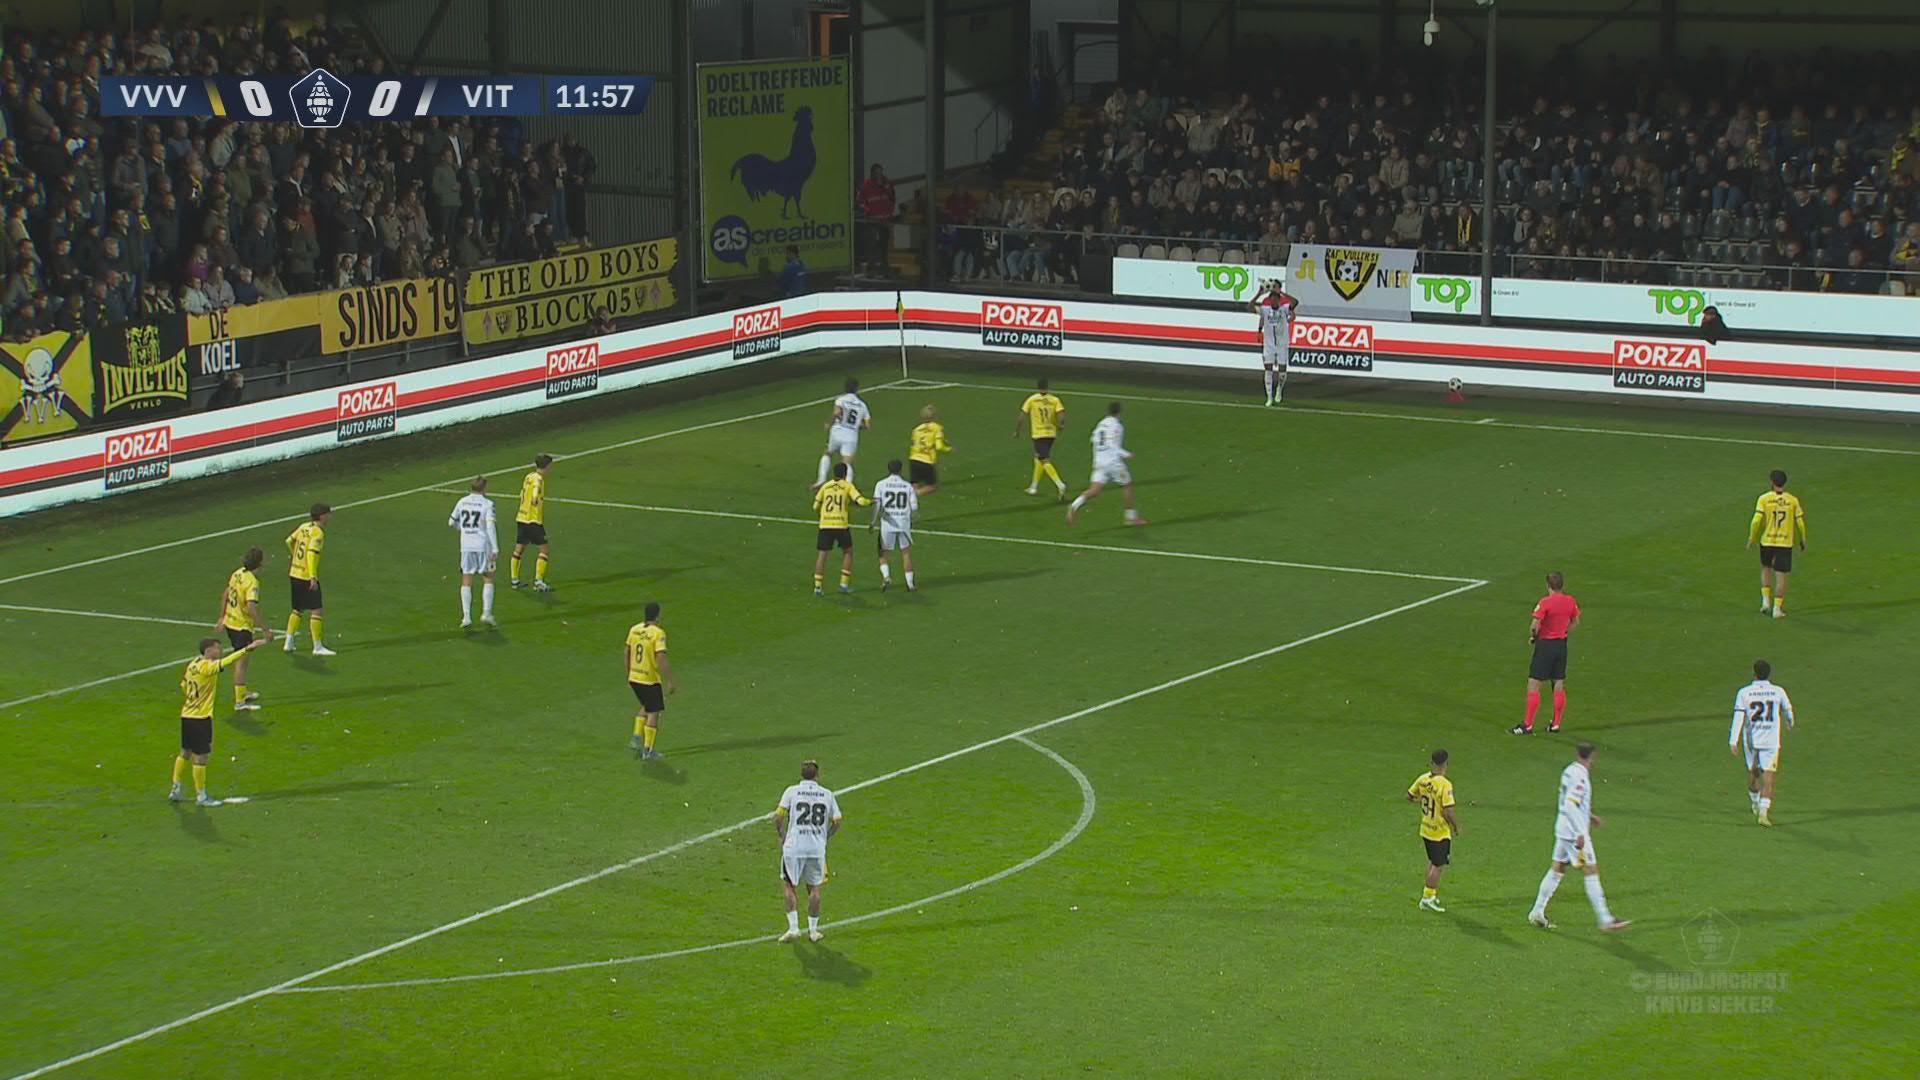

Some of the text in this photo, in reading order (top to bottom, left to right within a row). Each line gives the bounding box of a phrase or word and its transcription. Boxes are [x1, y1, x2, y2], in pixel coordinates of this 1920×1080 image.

[706, 66, 843, 94] DOELTREFFENDE
[707, 94, 785, 118] RECLAME
[751, 220, 845, 244] creation
[480, 243, 659, 300] THE OLD BOYS
[1198, 265, 1249, 300] TOP
[1416, 276, 1472, 313] TOP
[1647, 288, 1705, 325] TOP
[338, 281, 418, 348] SINDS
[516, 286, 632, 333] BLOCK 05
[984, 305, 1060, 328] PORZA
[208, 307, 229, 341] DE
[734, 310, 781, 338] PORZA
[1292, 324, 1370, 348] PORZA
[734, 337, 780, 356] AUTO PARTS
[985, 331, 1060, 347] AUTO PARTS
[200, 338, 241, 376] KOEL
[548, 347, 597, 375] PORZA
[1291, 352, 1370, 369] AUTO PARTS
[1617, 343, 1702, 369] PORZA
[100, 347, 188, 415] INVICTUS
[548, 374, 597, 395] AUTO PARTS
[1617, 371, 1702, 389] AUTO PARTS
[129, 398, 162, 411] VENLO
[340, 386, 395, 417] PORZA
[339, 415, 394, 437] AUTO PARTS
[107, 429, 169, 463] PORZA
[107, 460, 169, 485] AUTO PARTS
[825, 494, 843, 513] 24
[884, 491, 908, 510] 20
[461, 509, 481, 529] 27
[1772, 510, 1786, 529] 17
[635, 643, 644, 665] 8
[1749, 700, 1774, 722] 21
[796, 801, 827, 827] 28
